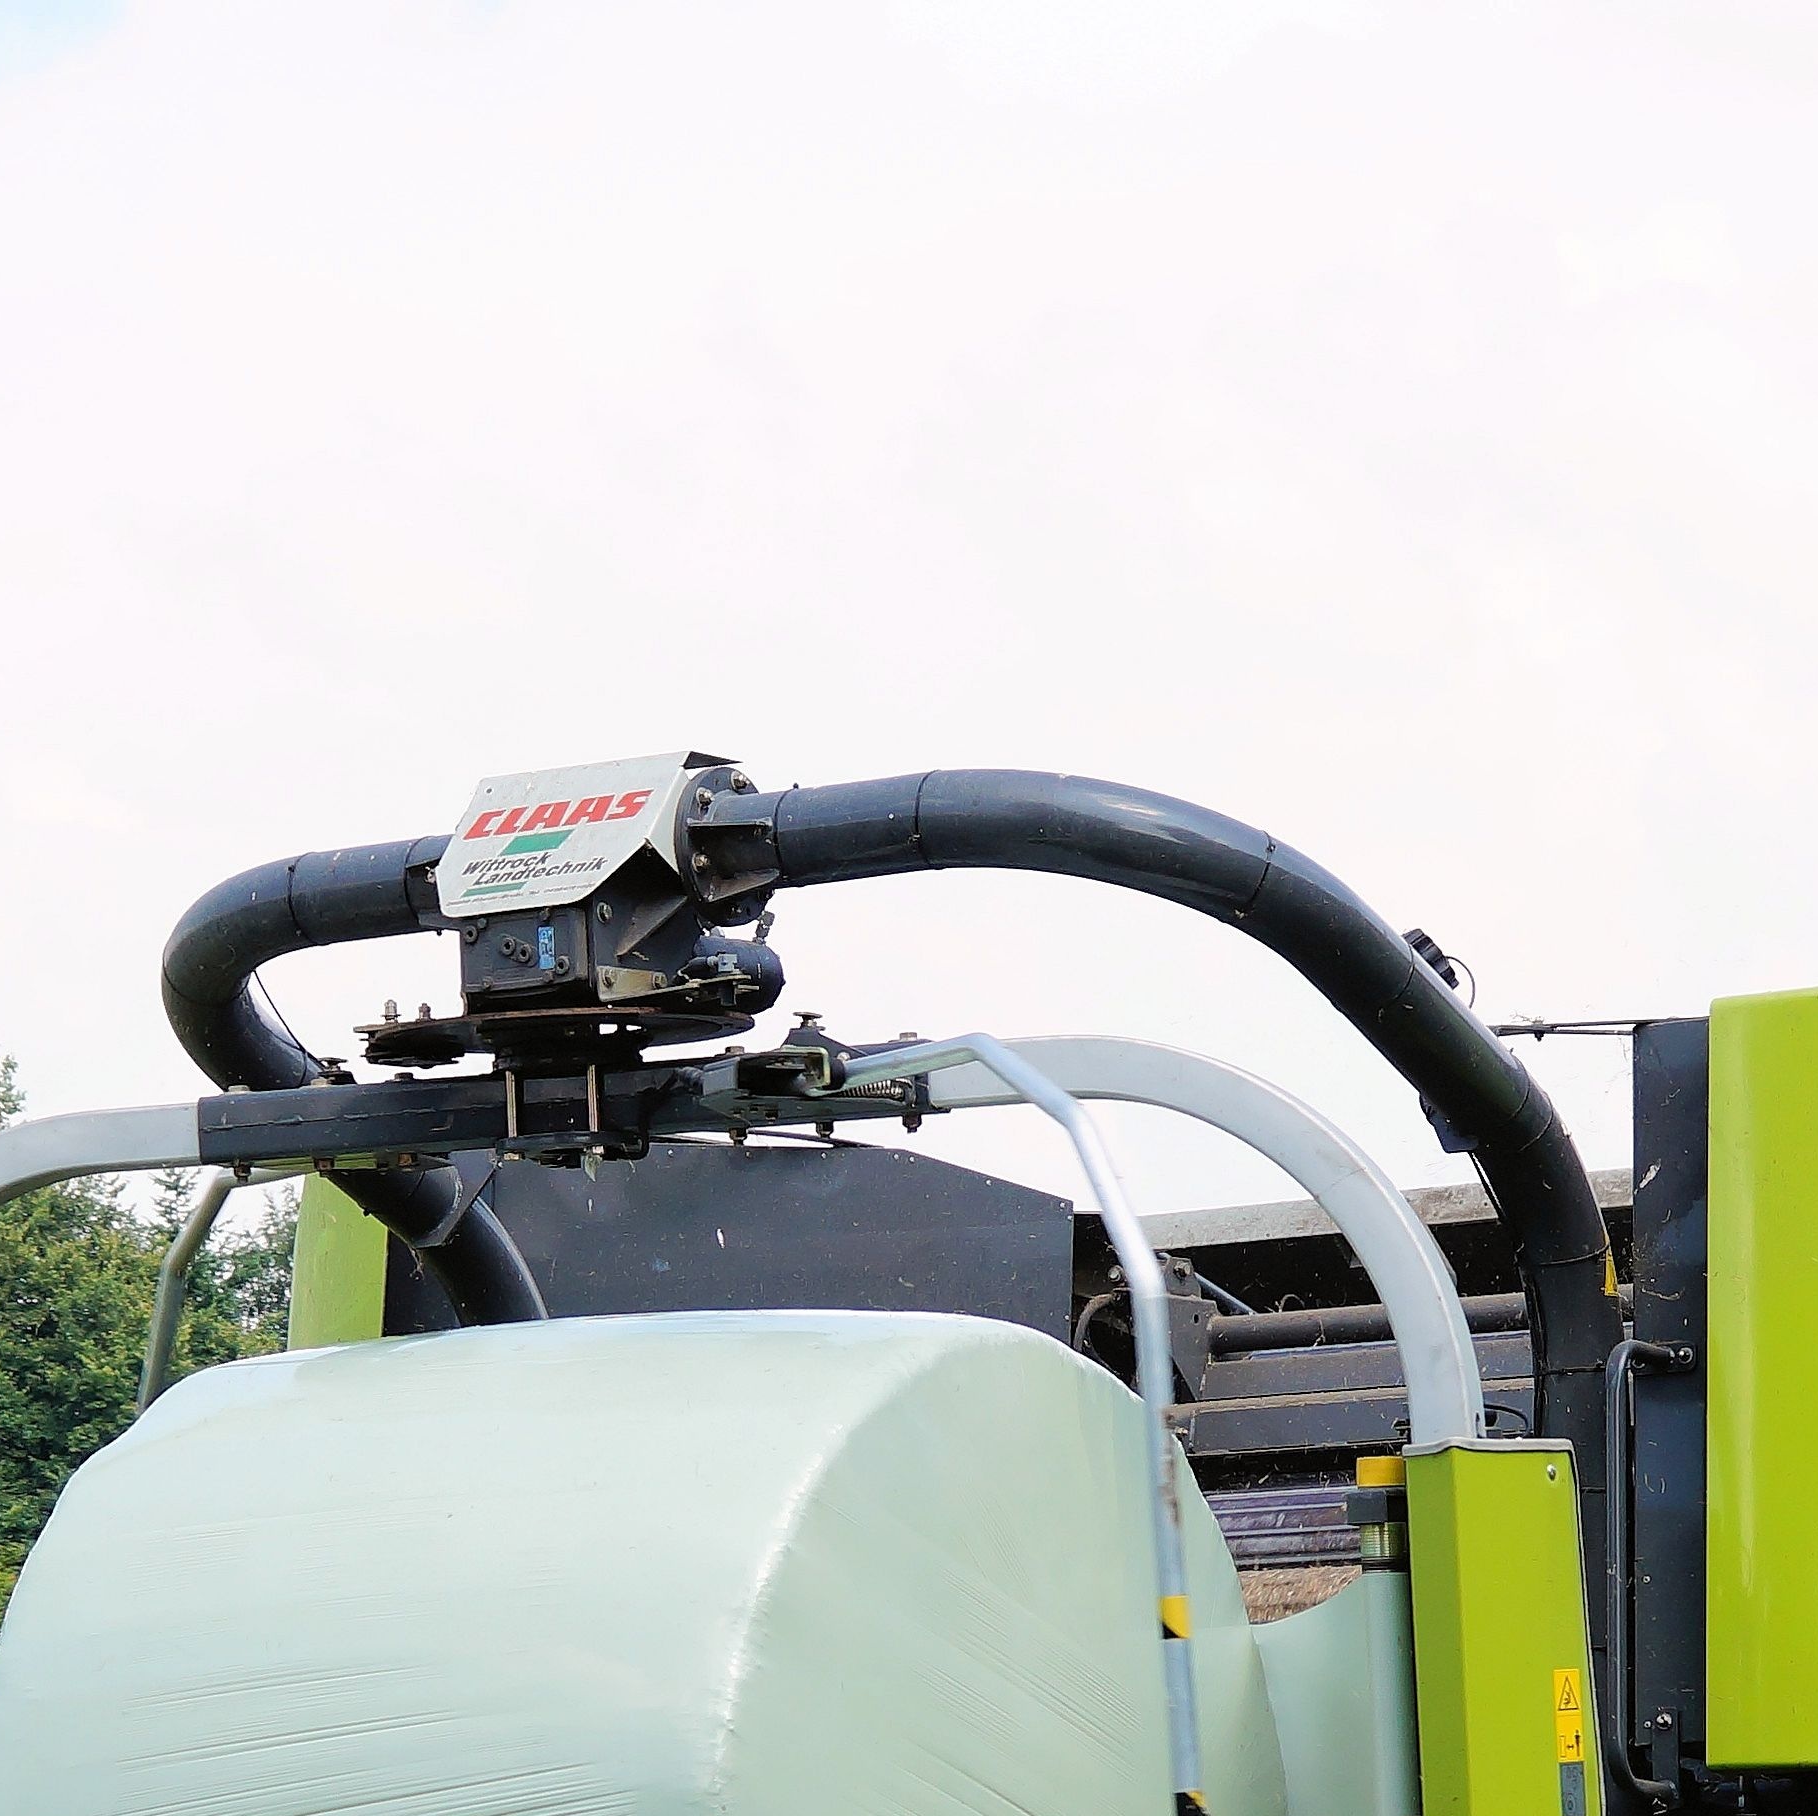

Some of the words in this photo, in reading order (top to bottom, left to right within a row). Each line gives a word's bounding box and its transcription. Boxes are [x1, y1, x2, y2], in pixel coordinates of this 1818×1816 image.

[463, 789, 654, 840] CLAAS
[461, 852, 552, 876] Wittrock
[473, 857, 608, 886] Landtechnik
